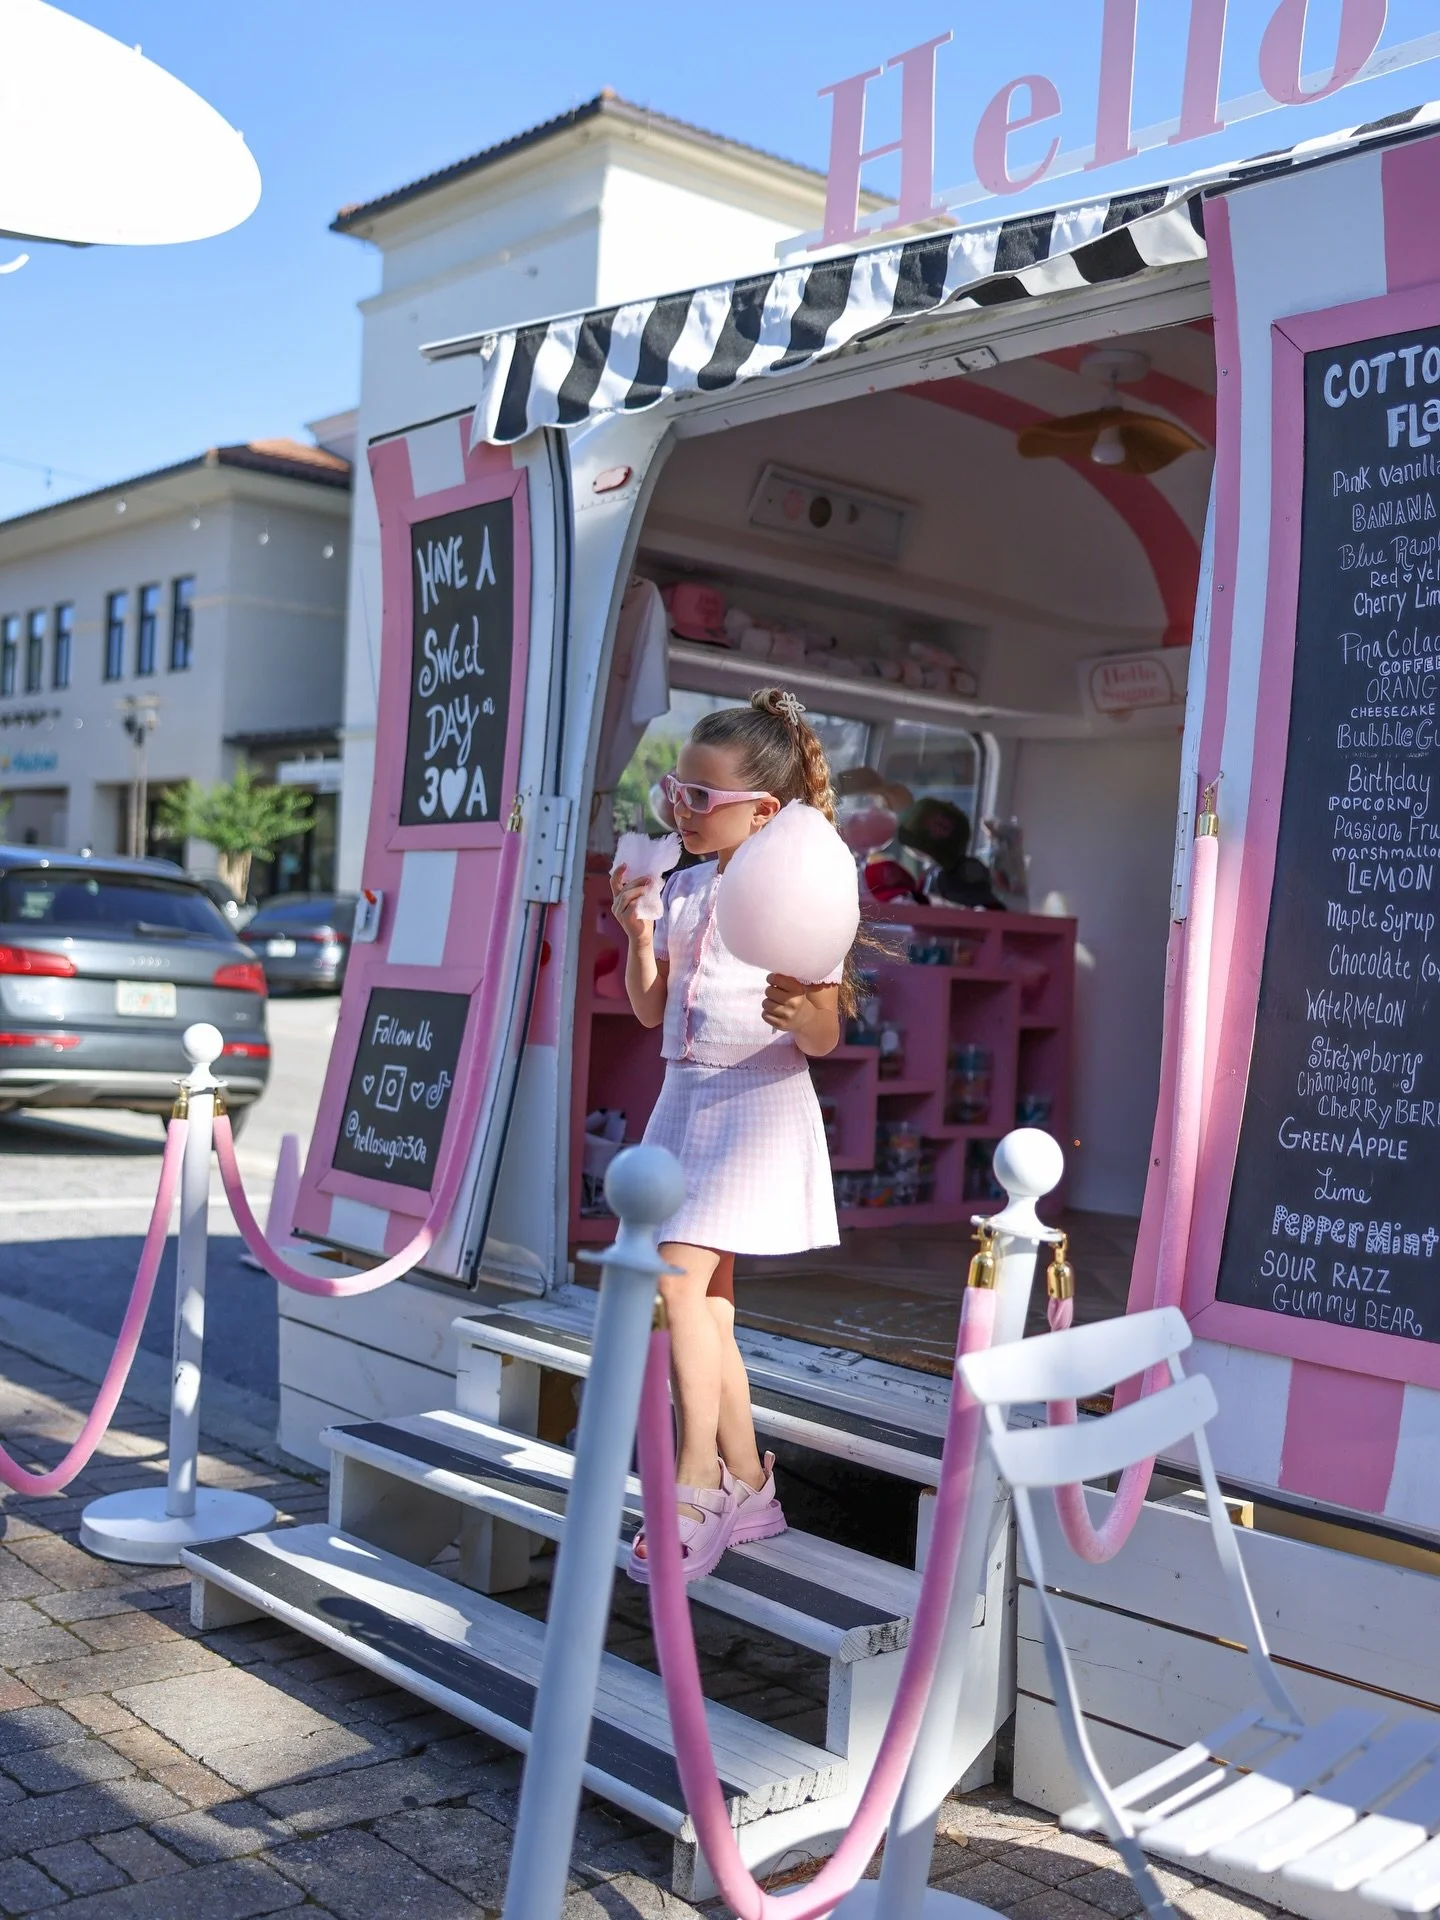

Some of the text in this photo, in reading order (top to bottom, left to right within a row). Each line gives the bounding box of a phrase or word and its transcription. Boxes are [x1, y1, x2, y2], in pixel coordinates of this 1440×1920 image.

[806, 0, 1388, 252] Hello
[1323, 345, 1440, 408] COTTO
[1333, 466, 1372, 497] Pink
[1353, 492, 1437, 532] BANANA
[417, 534, 468, 615] HAVE
[1337, 543, 1387, 570] Blue
[1370, 567, 1398, 588] Red
[1354, 592, 1407, 622] Cherry
[418, 615, 485, 698] Sweet
[1366, 674, 1438, 703] ORANG
[1351, 703, 1436, 718] CHEESECAKE
[1328, 797, 1410, 811] POPCORN
[1348, 761, 1430, 818] Birthday
[1334, 815, 1402, 841] Passion
[1348, 862, 1433, 894] LEMON
[1327, 900, 1435, 942] Maple Syrup
[1329, 944, 1411, 979] Chocolate
[372, 1014, 434, 1051] Follow Us
[1308, 1036, 1423, 1093] Strawberry
[1297, 1071, 1377, 1096] Champagne
[1395, 1099, 1440, 1127] BER
[1314, 1167, 1371, 1204] Lime
[1260, 1250, 1391, 1294] SOUR RAZZ
[1272, 1283, 1423, 1336] Gummy BEAR
